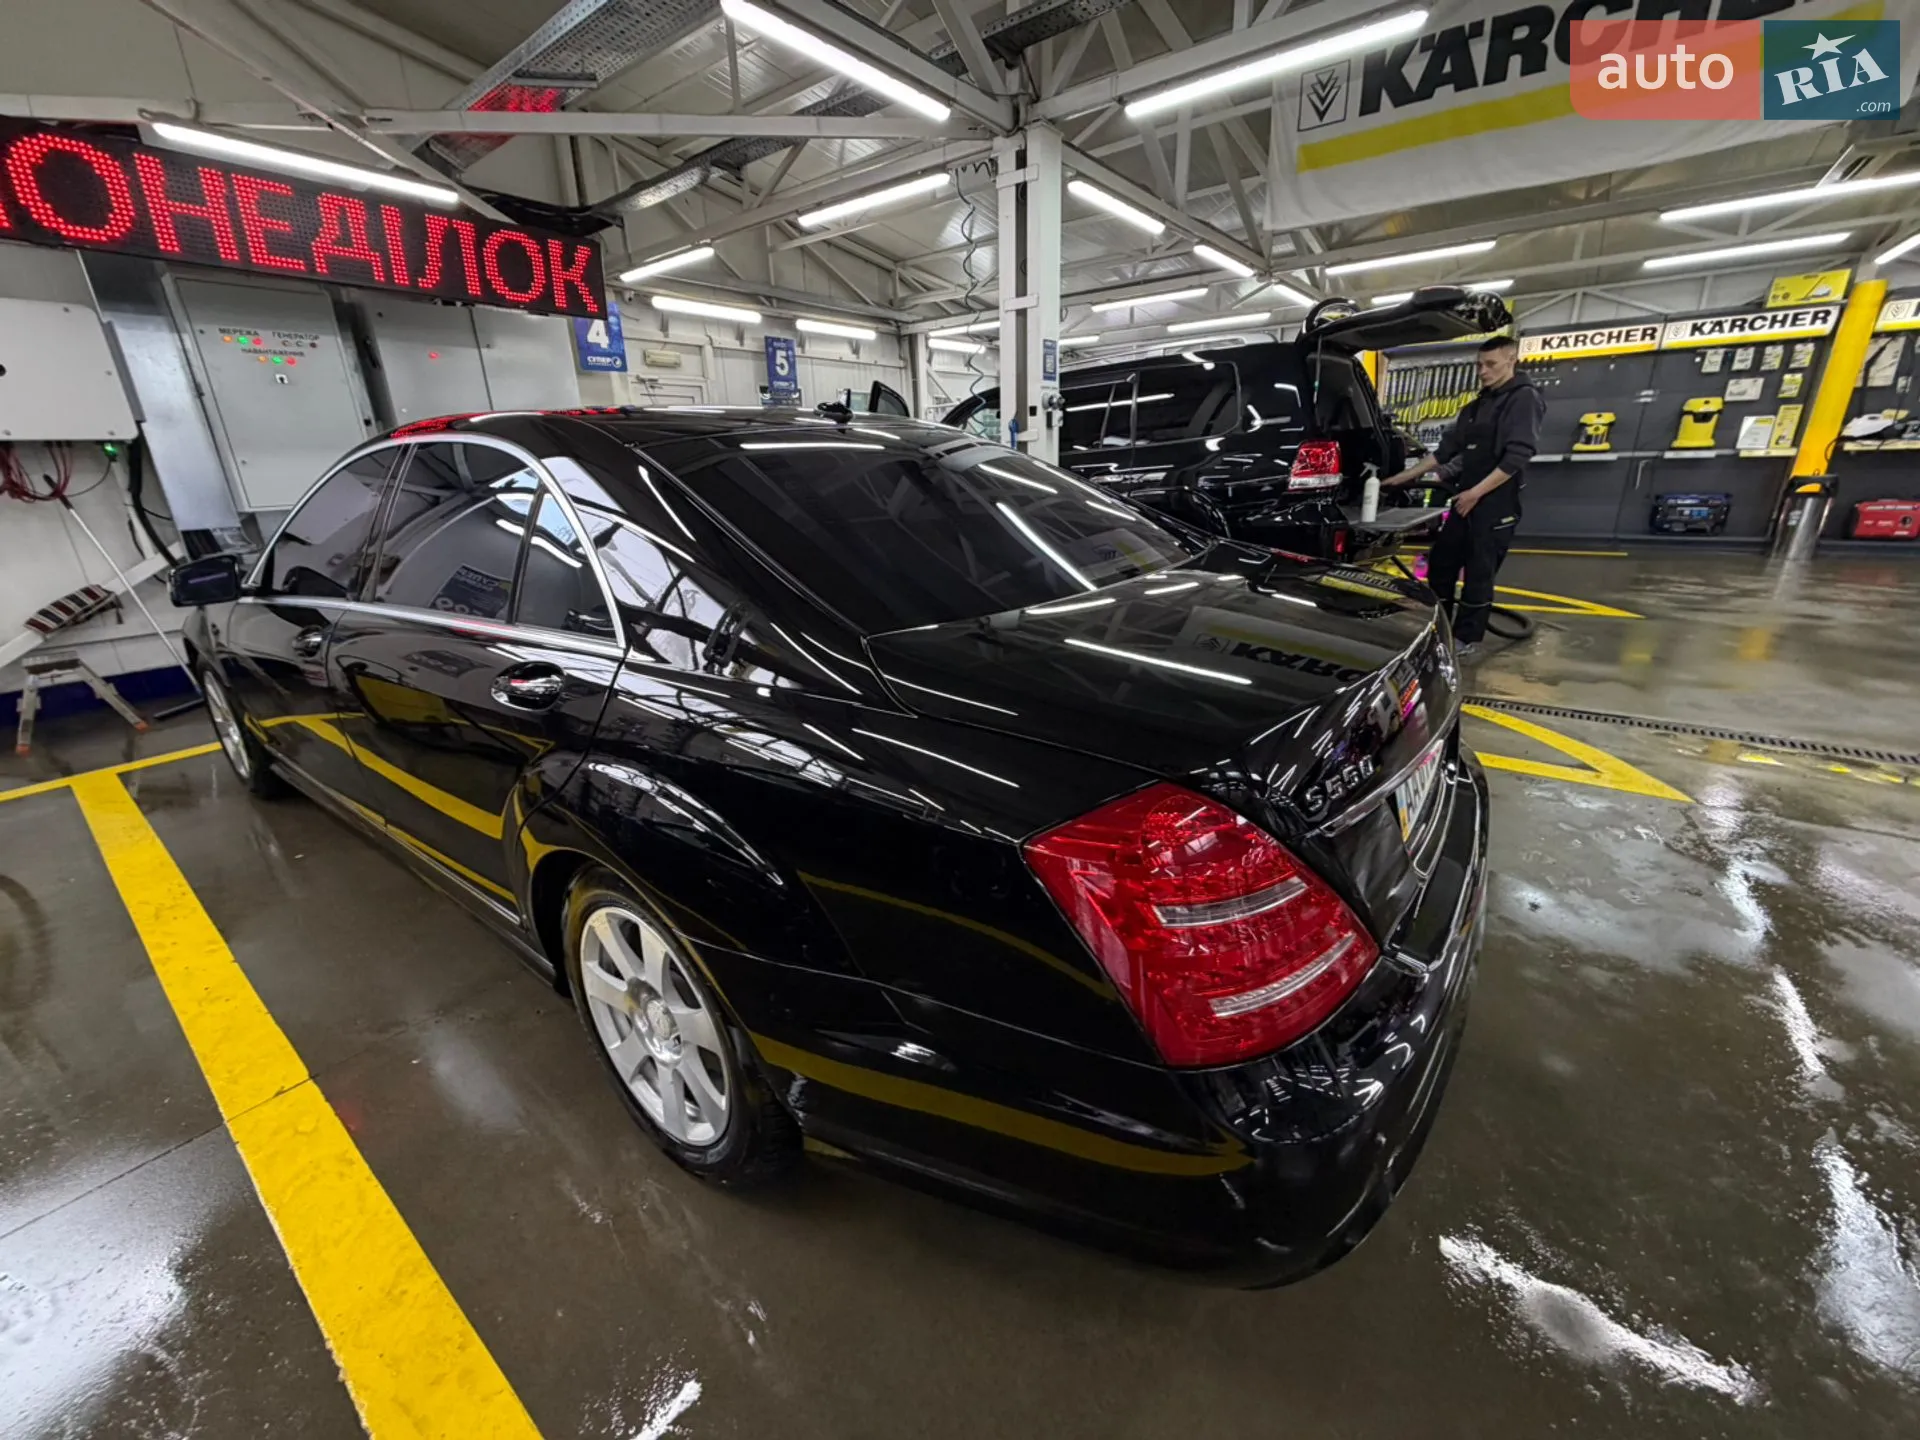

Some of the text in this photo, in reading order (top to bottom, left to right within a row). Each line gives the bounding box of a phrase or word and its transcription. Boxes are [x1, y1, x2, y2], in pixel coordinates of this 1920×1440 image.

[0, 132, 598, 314] ОНЕДІЛОК
[587, 319, 610, 349] 4
[1689, 308, 1831, 337] KÄRCHER
[1540, 326, 1658, 351] KÄRCHER
[775, 349, 789, 376] 5
